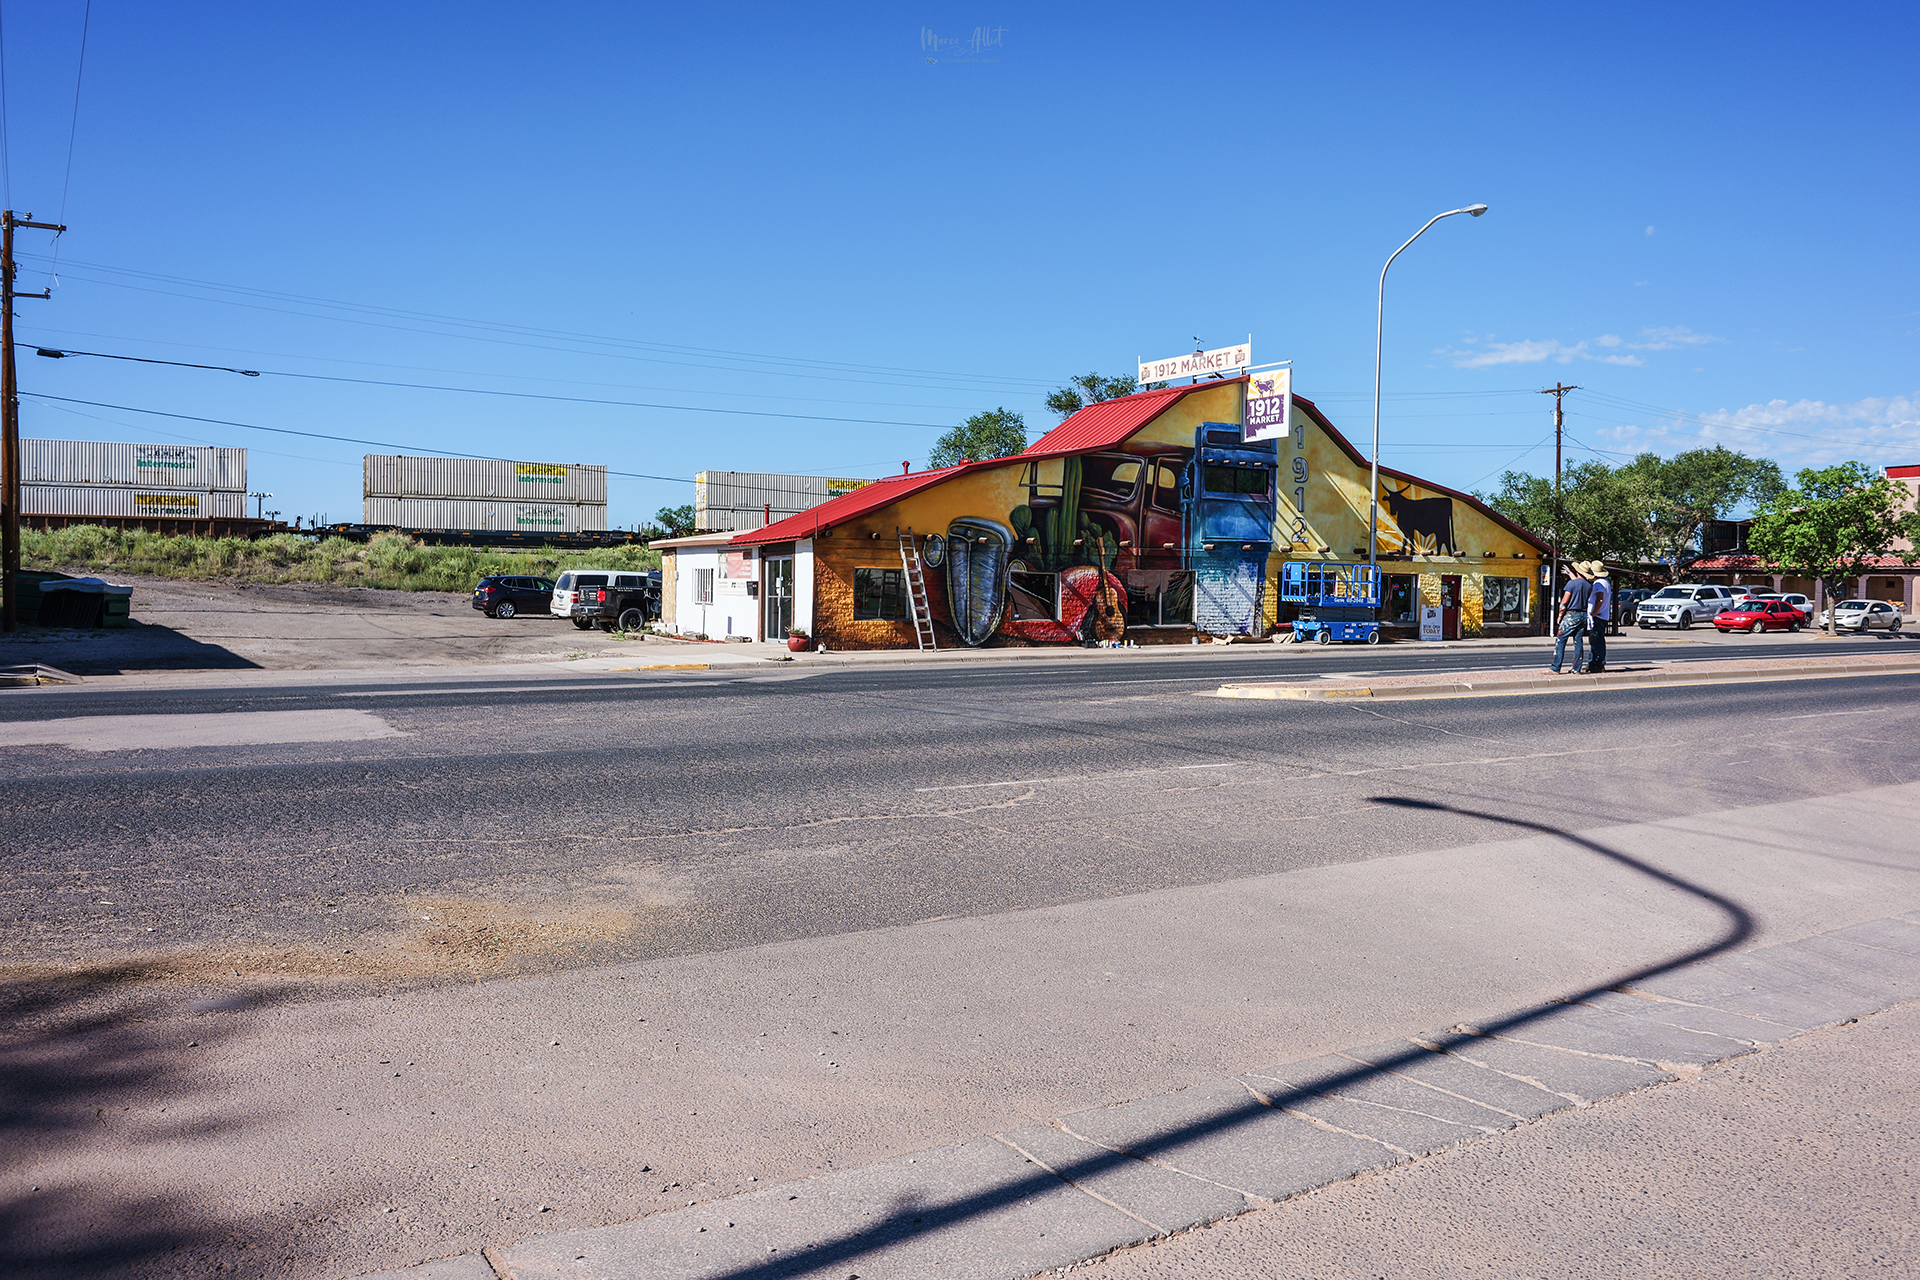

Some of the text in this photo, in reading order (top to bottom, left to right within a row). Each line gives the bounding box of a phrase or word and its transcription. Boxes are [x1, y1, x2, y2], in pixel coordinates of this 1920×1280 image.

[1154, 361, 1177, 378] 1912
[1181, 352, 1231, 373] MARKET
[1249, 397, 1280, 417] 1912
[1250, 414, 1280, 425] MARKET
[137, 459, 196, 469] Intermodal
[518, 475, 565, 484] Intermodal
[137, 506, 199, 515] Intermodal
[517, 517, 565, 526] Intermodal
